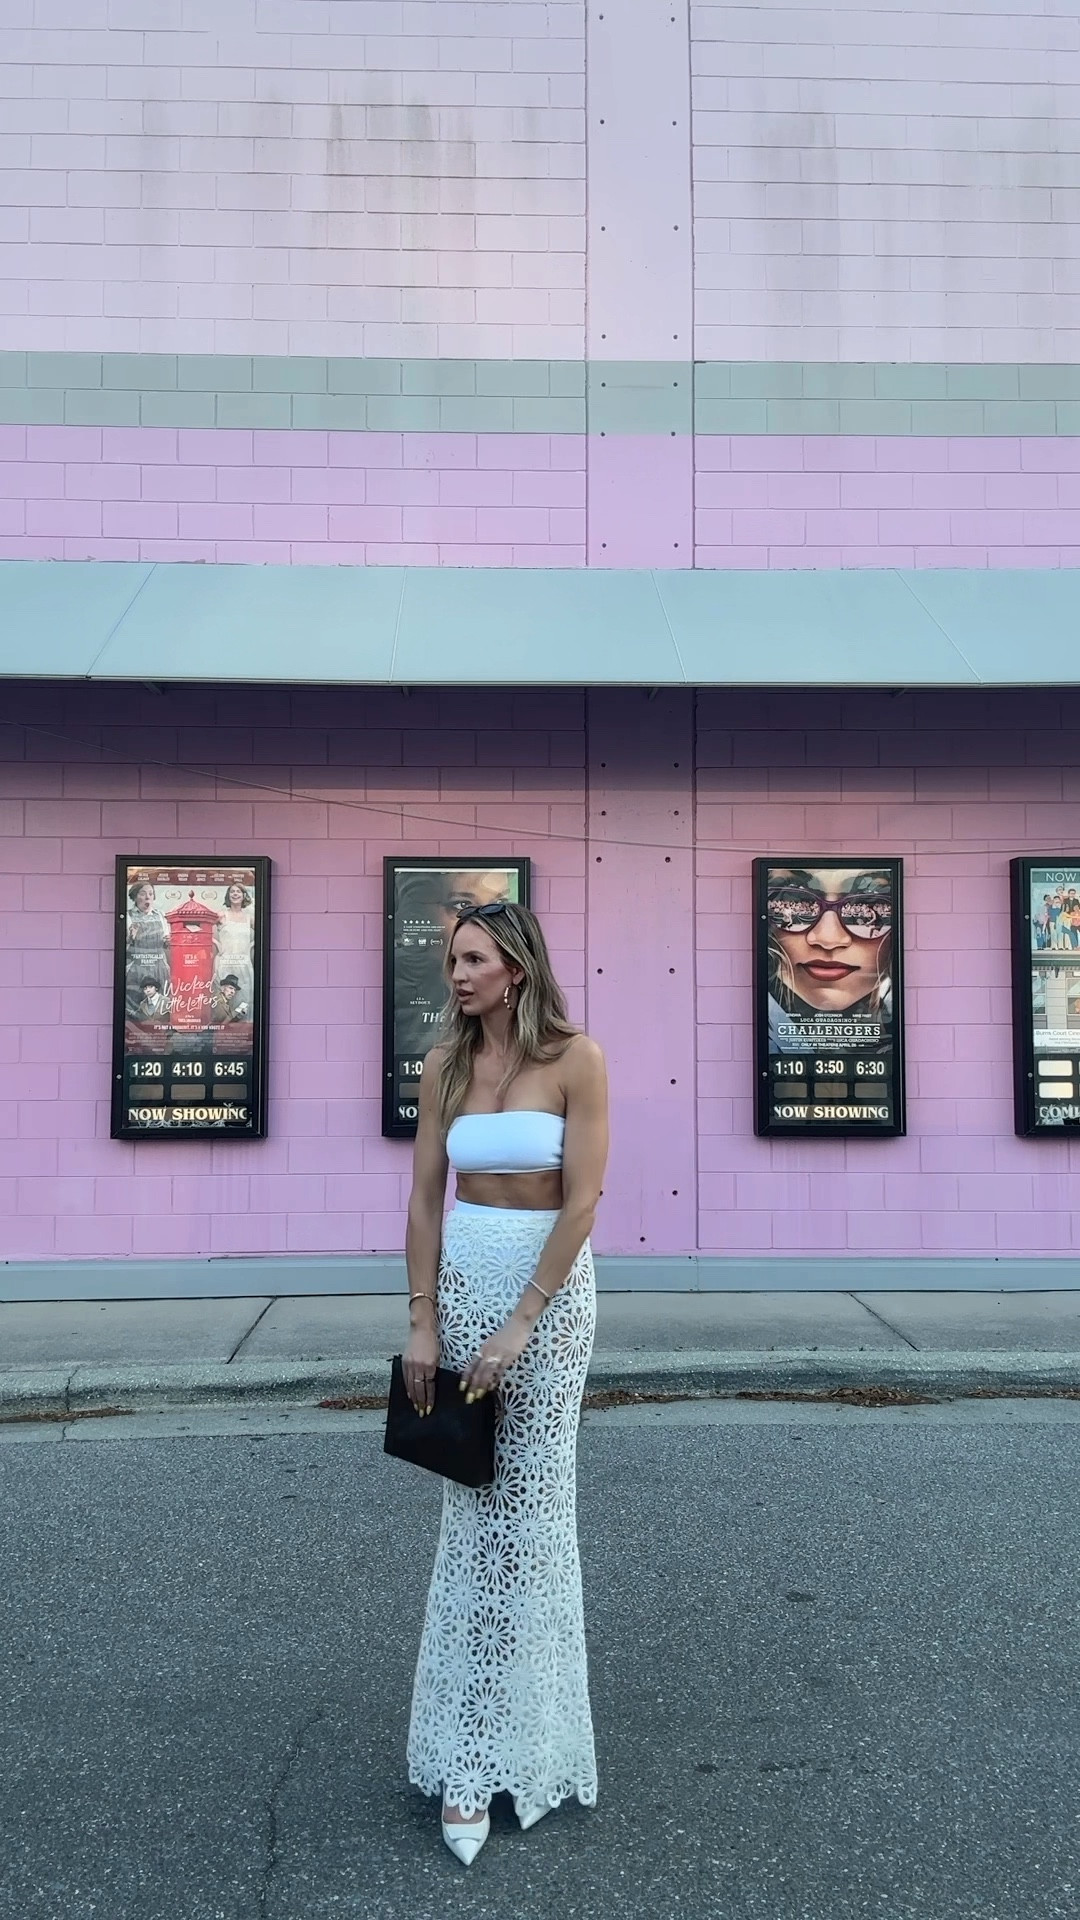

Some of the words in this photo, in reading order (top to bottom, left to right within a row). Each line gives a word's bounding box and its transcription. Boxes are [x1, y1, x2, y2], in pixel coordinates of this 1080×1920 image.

[1045, 872, 1077, 882] NOW
[163, 972, 217, 996] Wicked
[160, 995, 187, 1015] Little
[187, 993, 219, 1012] Letters
[778, 1025, 881, 1035] CHALLENGERS
[132, 1062, 162, 1076] 1:20
[172, 1062, 203, 1076] 4:10
[214, 1062, 244, 1076] 6:45
[403, 1061, 423, 1075] 1:0
[775, 1061, 804, 1075] 1:10
[815, 1060, 844, 1074] 3:50
[856, 1061, 885, 1075] 6:30
[128, 1108, 166, 1121] NOW
[399, 1106, 418, 1118] NO
[774, 1106, 808, 1118] NOW
[813, 1106, 889, 1118] SHOWING
